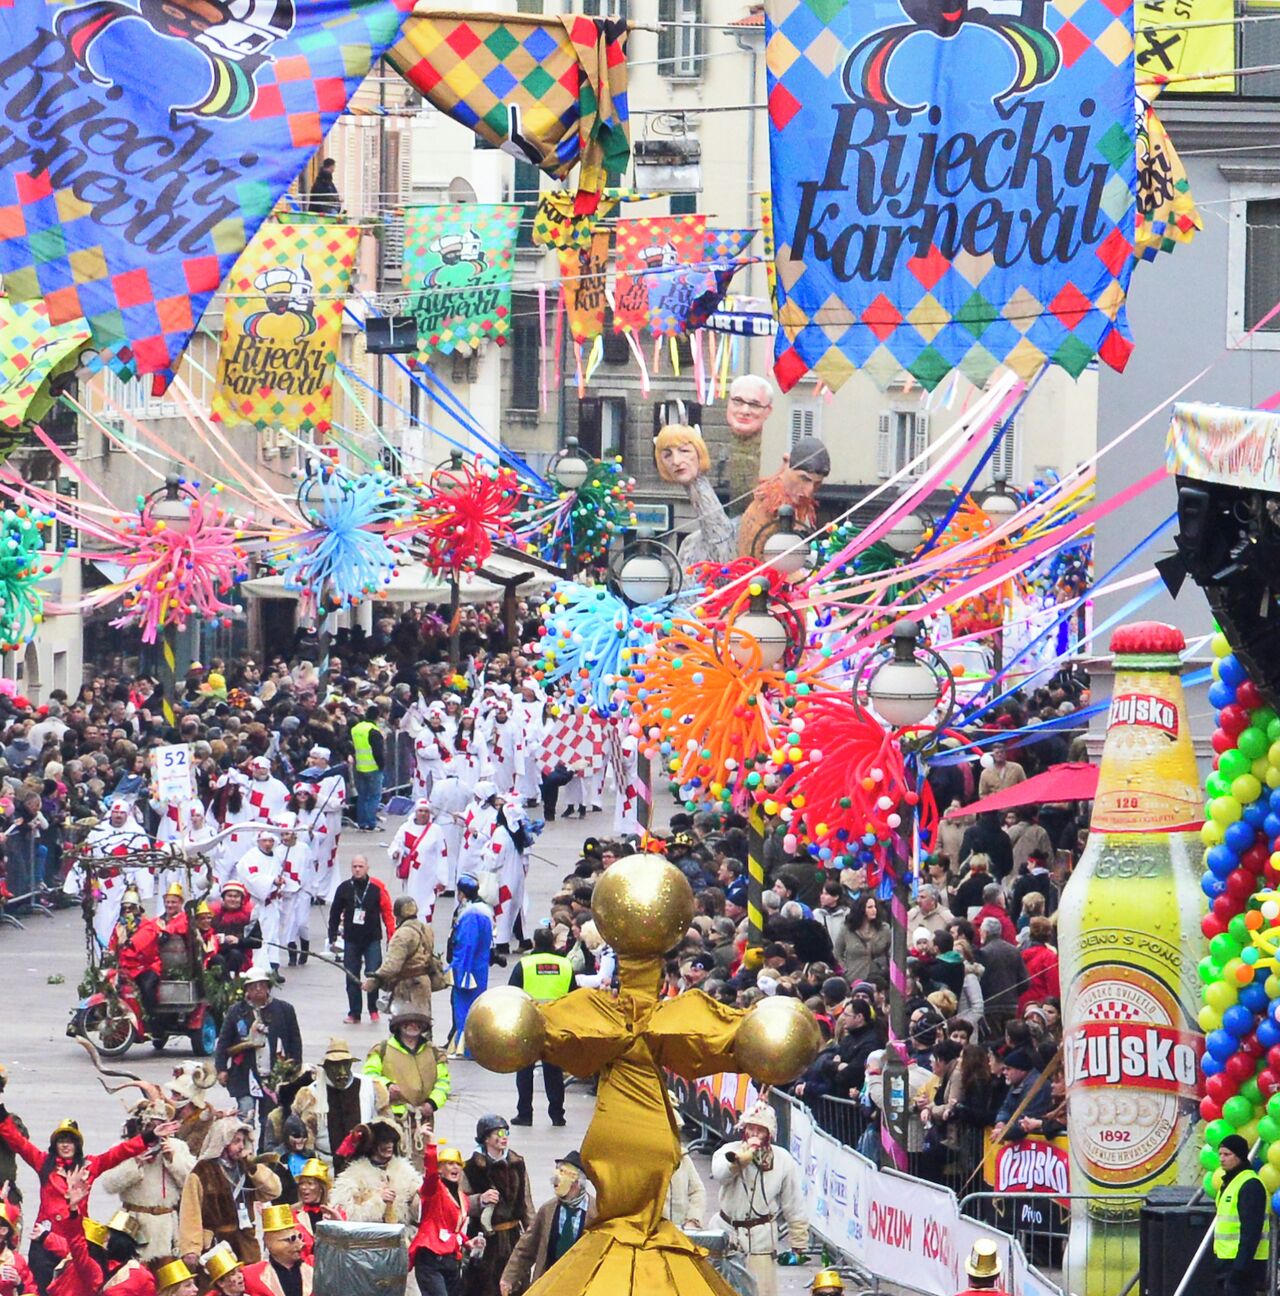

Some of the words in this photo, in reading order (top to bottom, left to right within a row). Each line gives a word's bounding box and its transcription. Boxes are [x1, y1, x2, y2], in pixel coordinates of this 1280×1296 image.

[821, 98, 1097, 219] Riječki
[790, 163, 1110, 282] karneval
[223, 359, 327, 395] karneval
[164, 751, 186, 767] 52
[1099, 1130, 1131, 1142] 1892
[999, 1143, 1068, 1195] Ožujsko
[868, 1200, 913, 1252] ONZUM
[1021, 1204, 1043, 1224] Pivo
